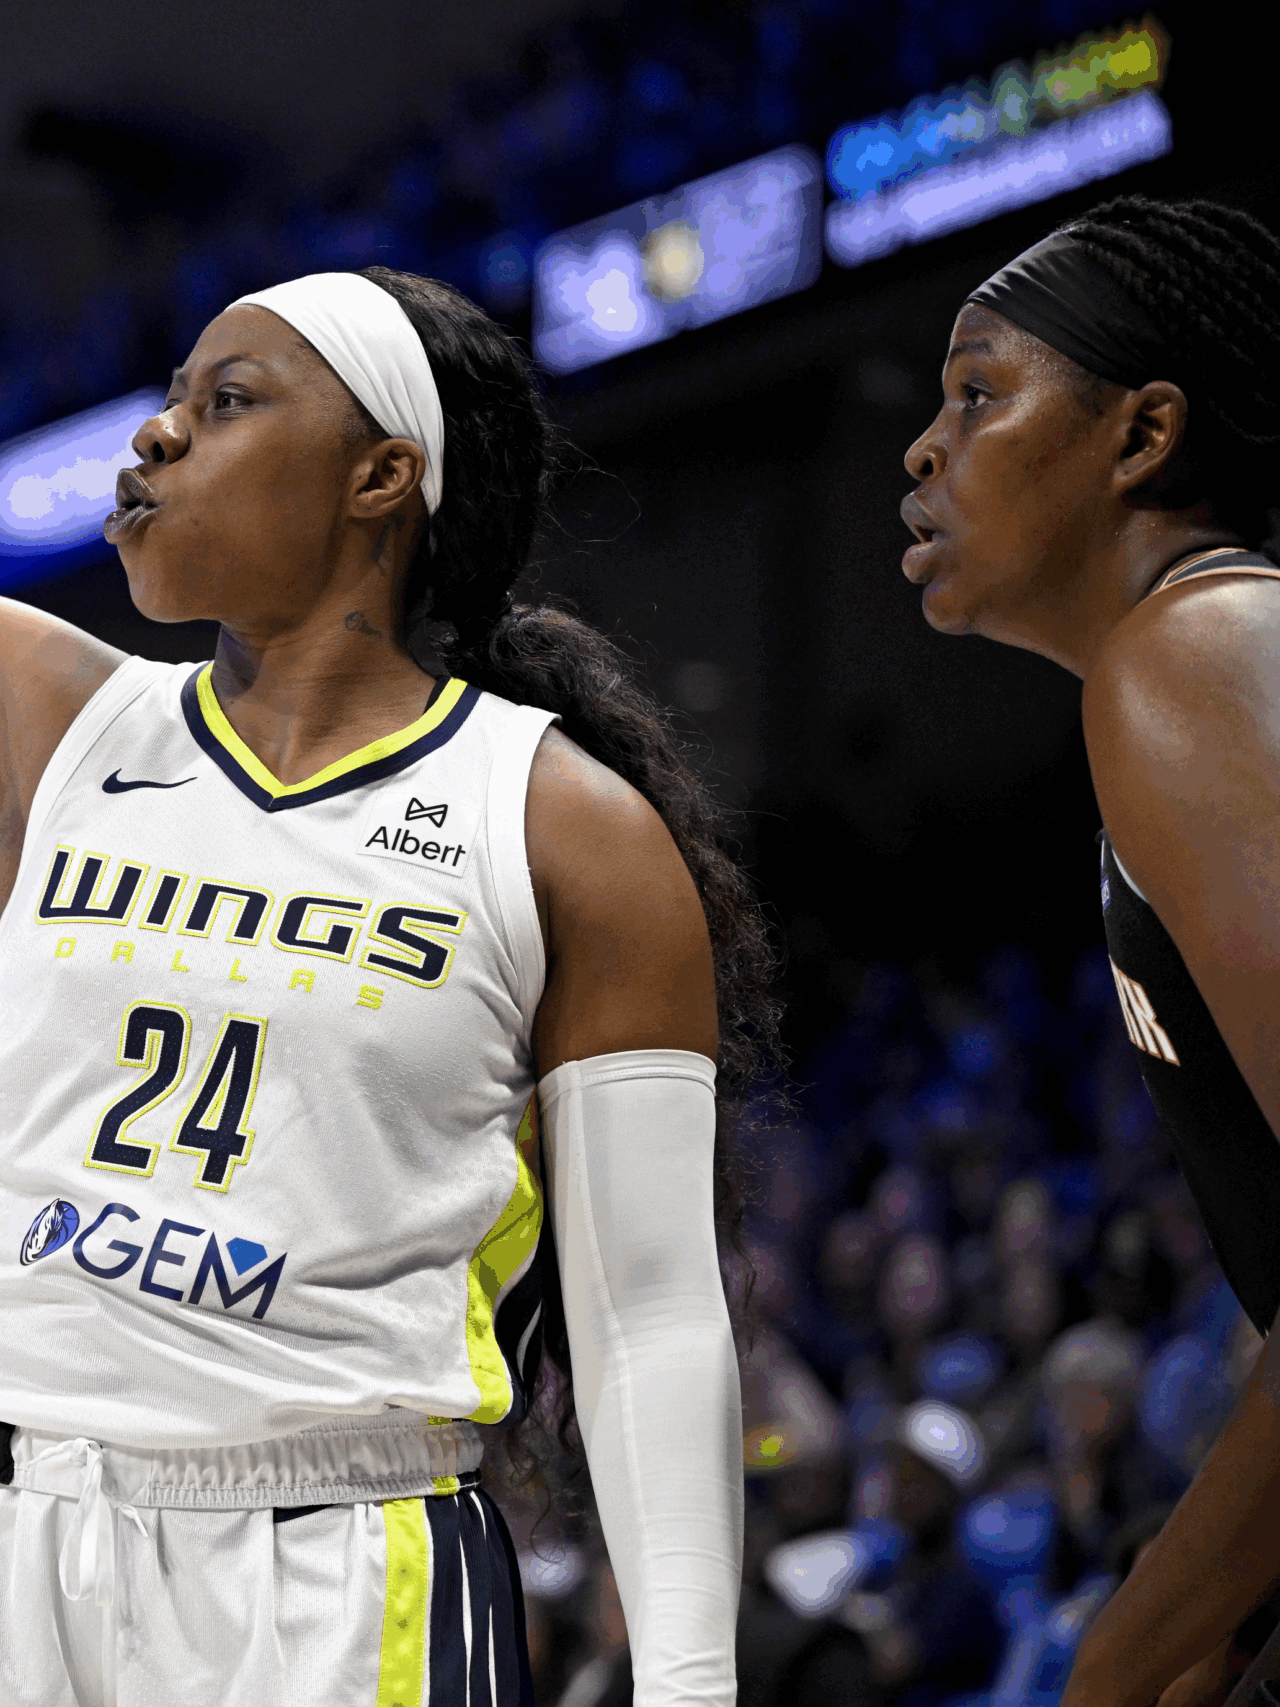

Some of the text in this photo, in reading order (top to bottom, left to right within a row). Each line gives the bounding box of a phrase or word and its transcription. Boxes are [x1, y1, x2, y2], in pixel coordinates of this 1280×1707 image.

[364, 825, 466, 867] Albert
[35, 844, 468, 989] WINGS
[54, 937, 385, 1011] DALLAS
[83, 999, 268, 1193] 24
[72, 1202, 288, 1320] GEM
